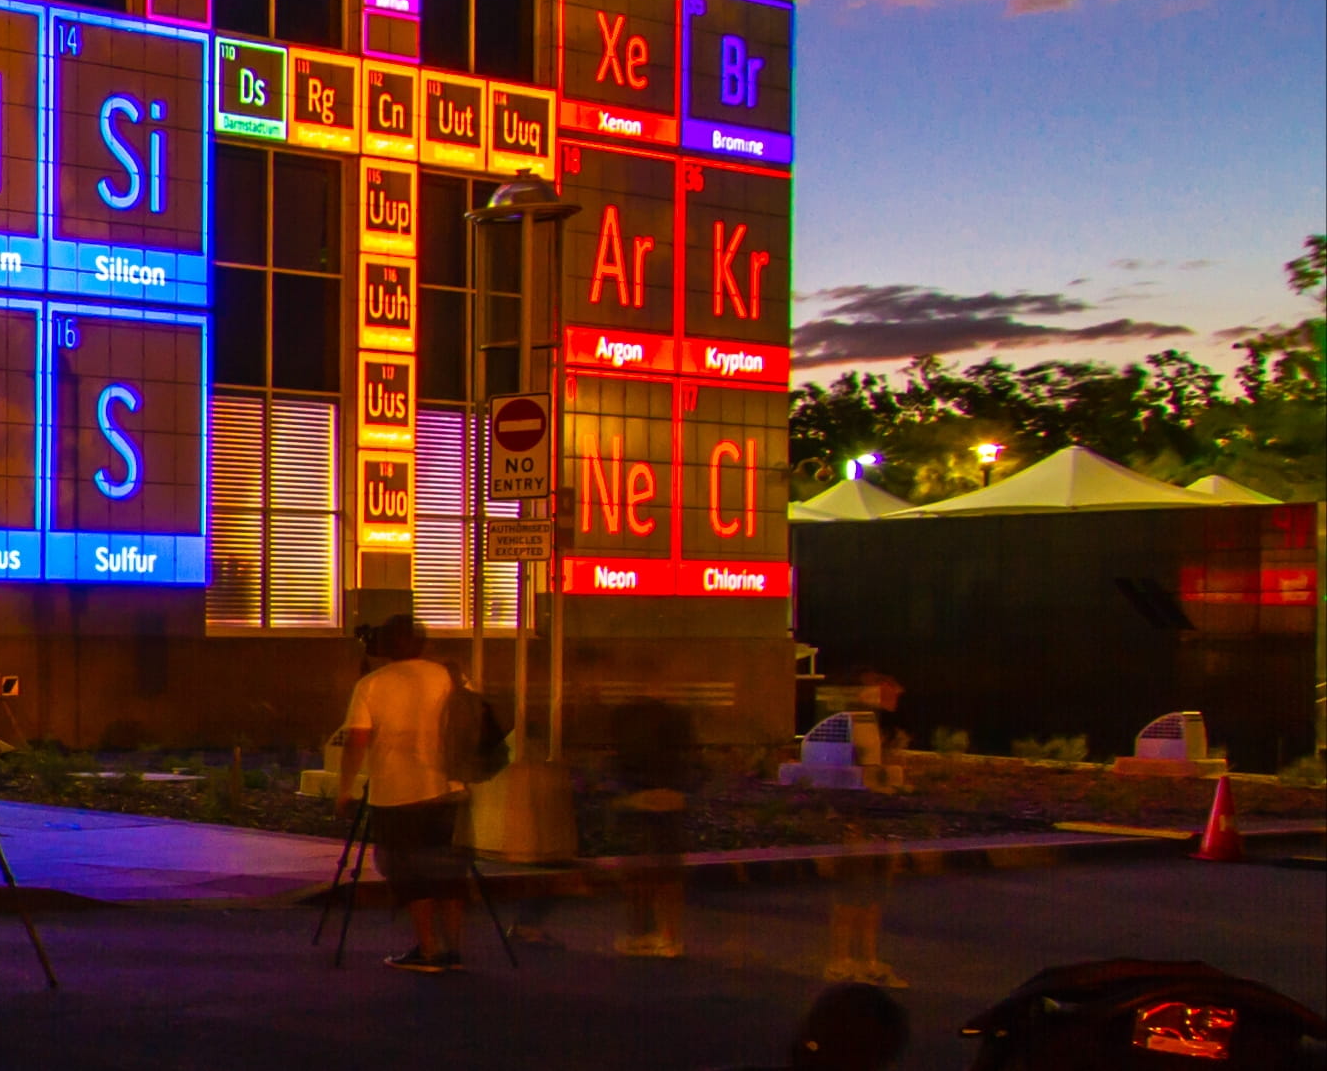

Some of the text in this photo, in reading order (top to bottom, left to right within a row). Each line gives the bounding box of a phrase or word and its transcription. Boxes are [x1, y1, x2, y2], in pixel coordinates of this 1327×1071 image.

[59, 25, 78, 55] 14
[597, 11, 647, 90] Xe
[239, 69, 265, 106] Ds
[722, 34, 763, 107] Br
[308, 78, 334, 124] Rg
[379, 94, 404, 129] Cn
[439, 100, 474, 137] Uut
[504, 110, 540, 154] Uuq
[598, 111, 641, 135] Xenon
[98, 96, 160, 212] Si
[369, 191, 409, 235] Uup
[95, 256, 165, 286] Silicon
[589, 205, 654, 309] Ar
[714, 221, 769, 320] Kr
[369, 285, 409, 319] Uuh
[57, 319, 76, 349] 16
[596, 337, 643, 366] Argon
[705, 346, 764, 377] Krypton
[368, 383, 406, 418] Uus
[95, 384, 138, 499] S
[506, 458, 534, 473] NO
[369, 481, 407, 517] Uuo
[494, 478, 544, 492] ENTRY
[582, 434, 656, 536] Ne
[496, 547, 543, 556] EXCEPTED
[497, 536, 542, 545] VEHICLES
[95, 548, 157, 572] Sulfur
[595, 567, 636, 589] Neon
[704, 567, 764, 591] Chlorine
